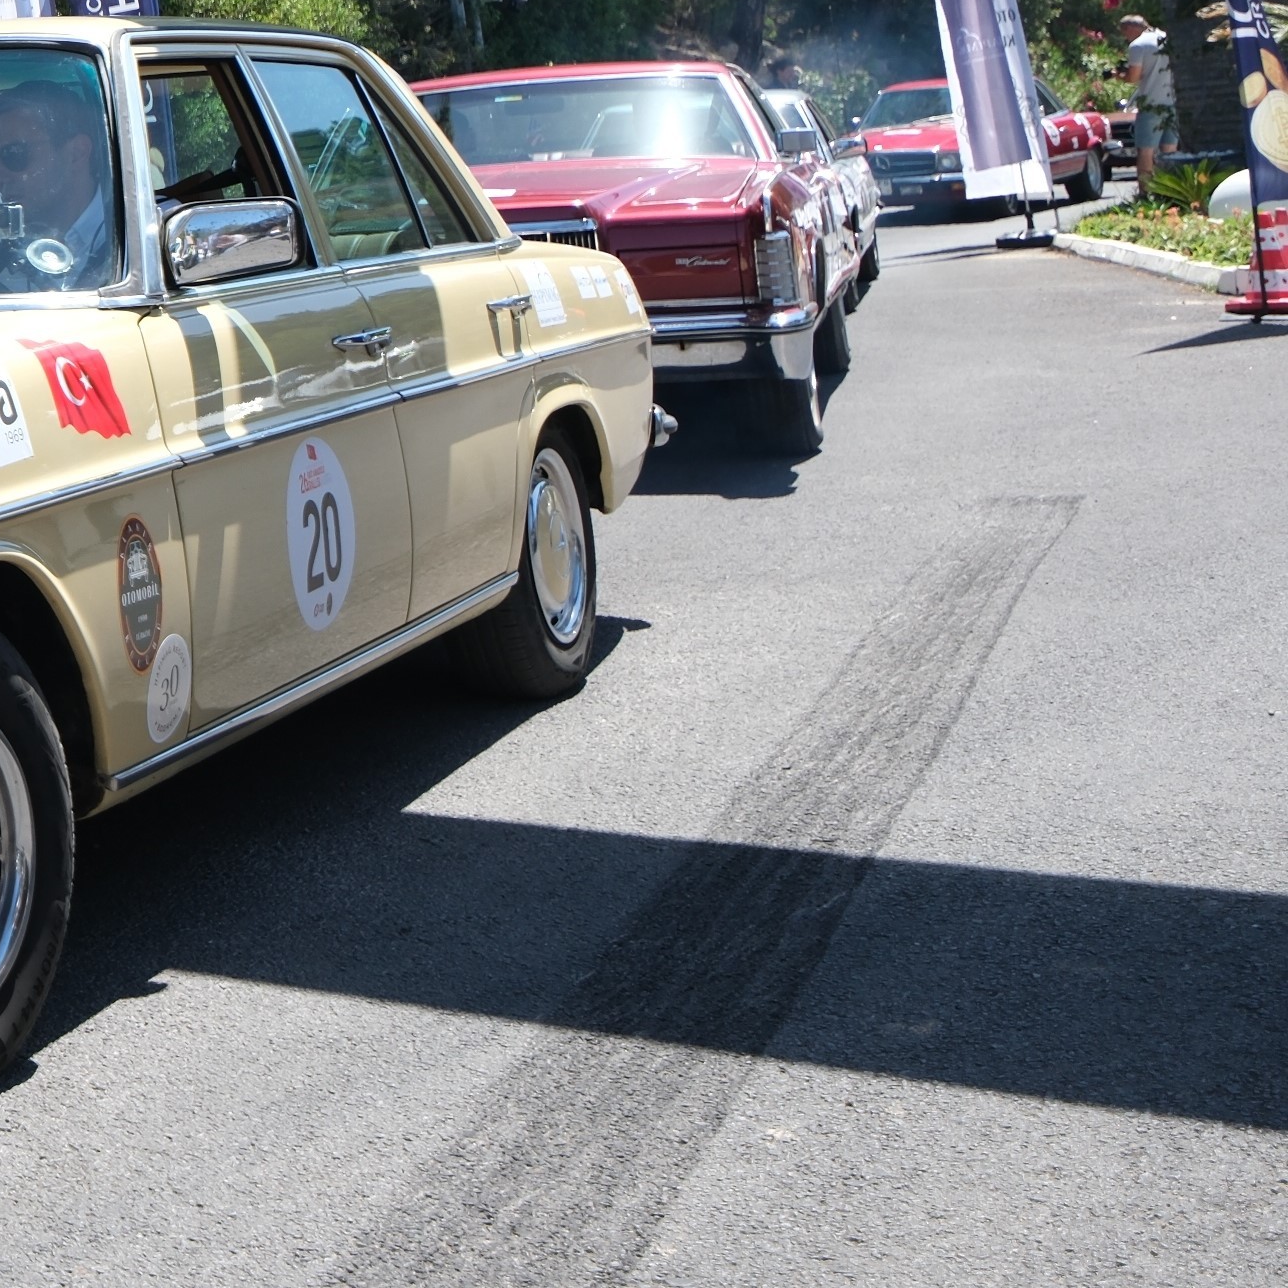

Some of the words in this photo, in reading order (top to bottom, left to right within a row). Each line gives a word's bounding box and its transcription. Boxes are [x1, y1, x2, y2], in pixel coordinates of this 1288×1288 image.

[5, 427, 25, 444] 1969
[302, 491, 343, 594] 20
[121, 580, 161, 608] OTOMOBİL
[159, 664, 180, 712] 30
